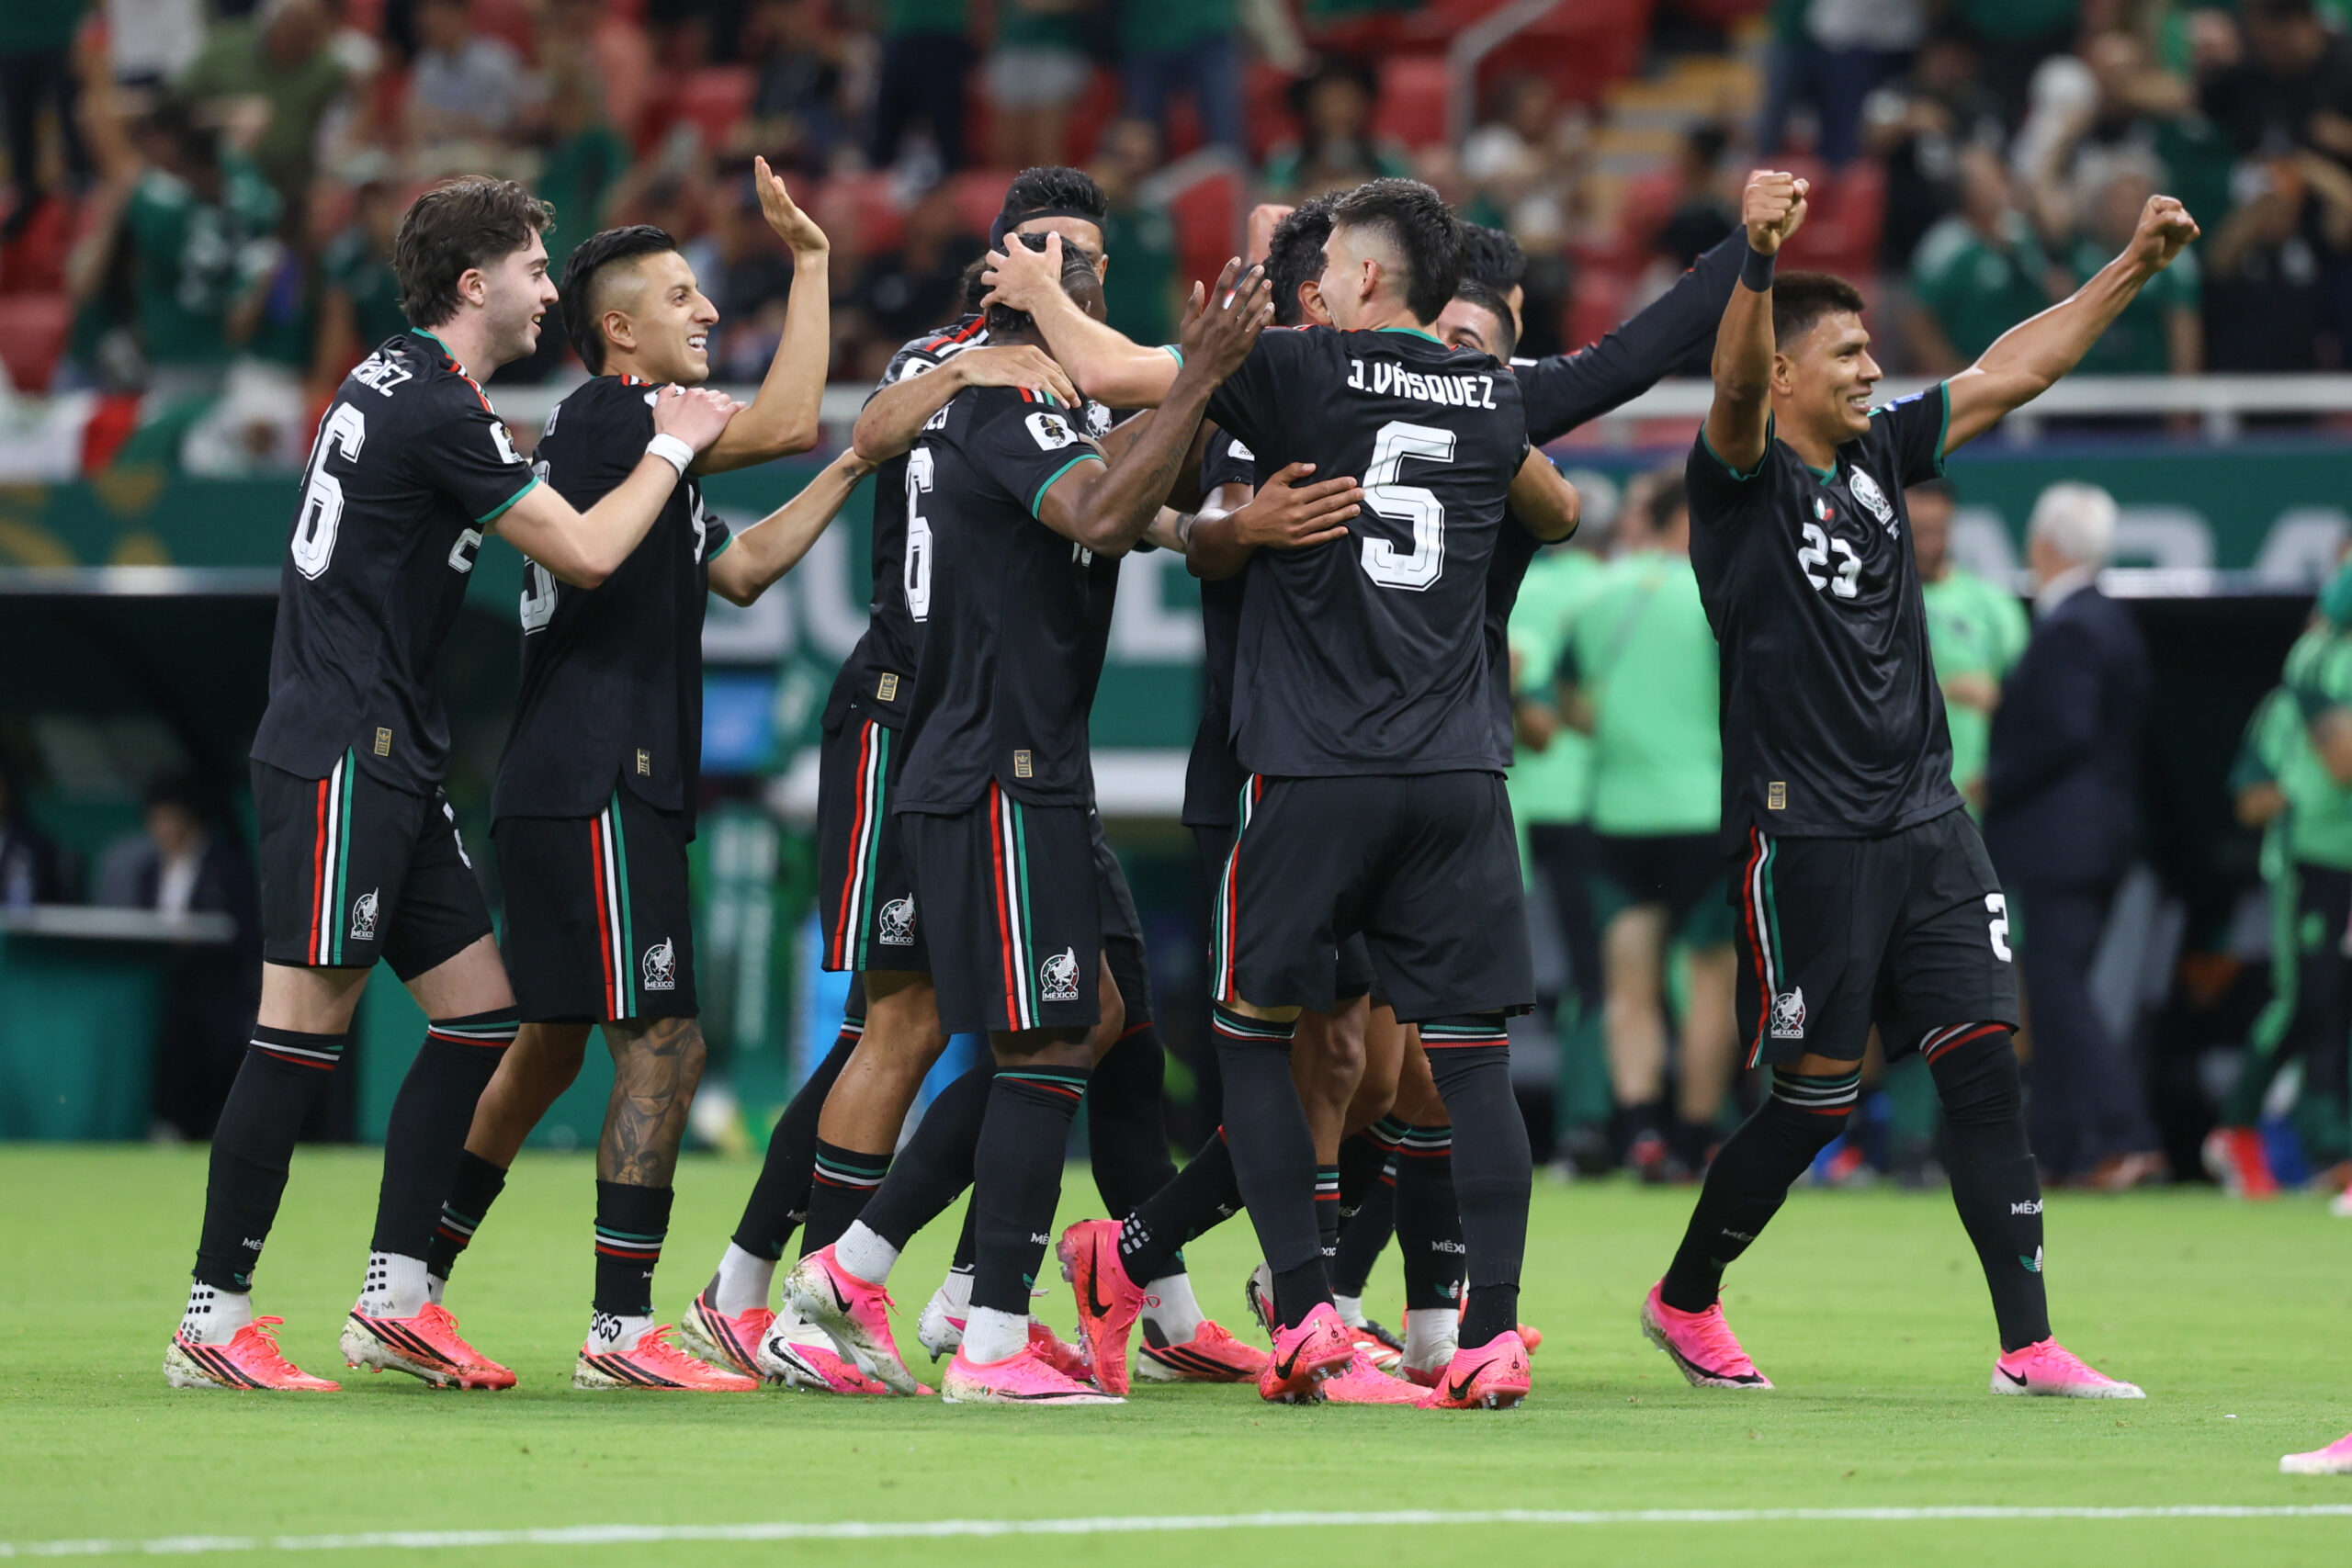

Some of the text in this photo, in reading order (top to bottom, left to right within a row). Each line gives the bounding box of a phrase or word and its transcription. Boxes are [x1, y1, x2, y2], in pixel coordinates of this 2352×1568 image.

[1347, 359, 1497, 411] J.VÁSQUEZ
[290, 401, 366, 581] 6
[1361, 421, 1456, 592] 5
[904, 447, 934, 623] 6
[1797, 522, 1862, 598] 23
[882, 934, 913, 944] MÉXICO
[647, 979, 673, 988] MÉXICO
[1044, 991, 1077, 999] MÉXICO
